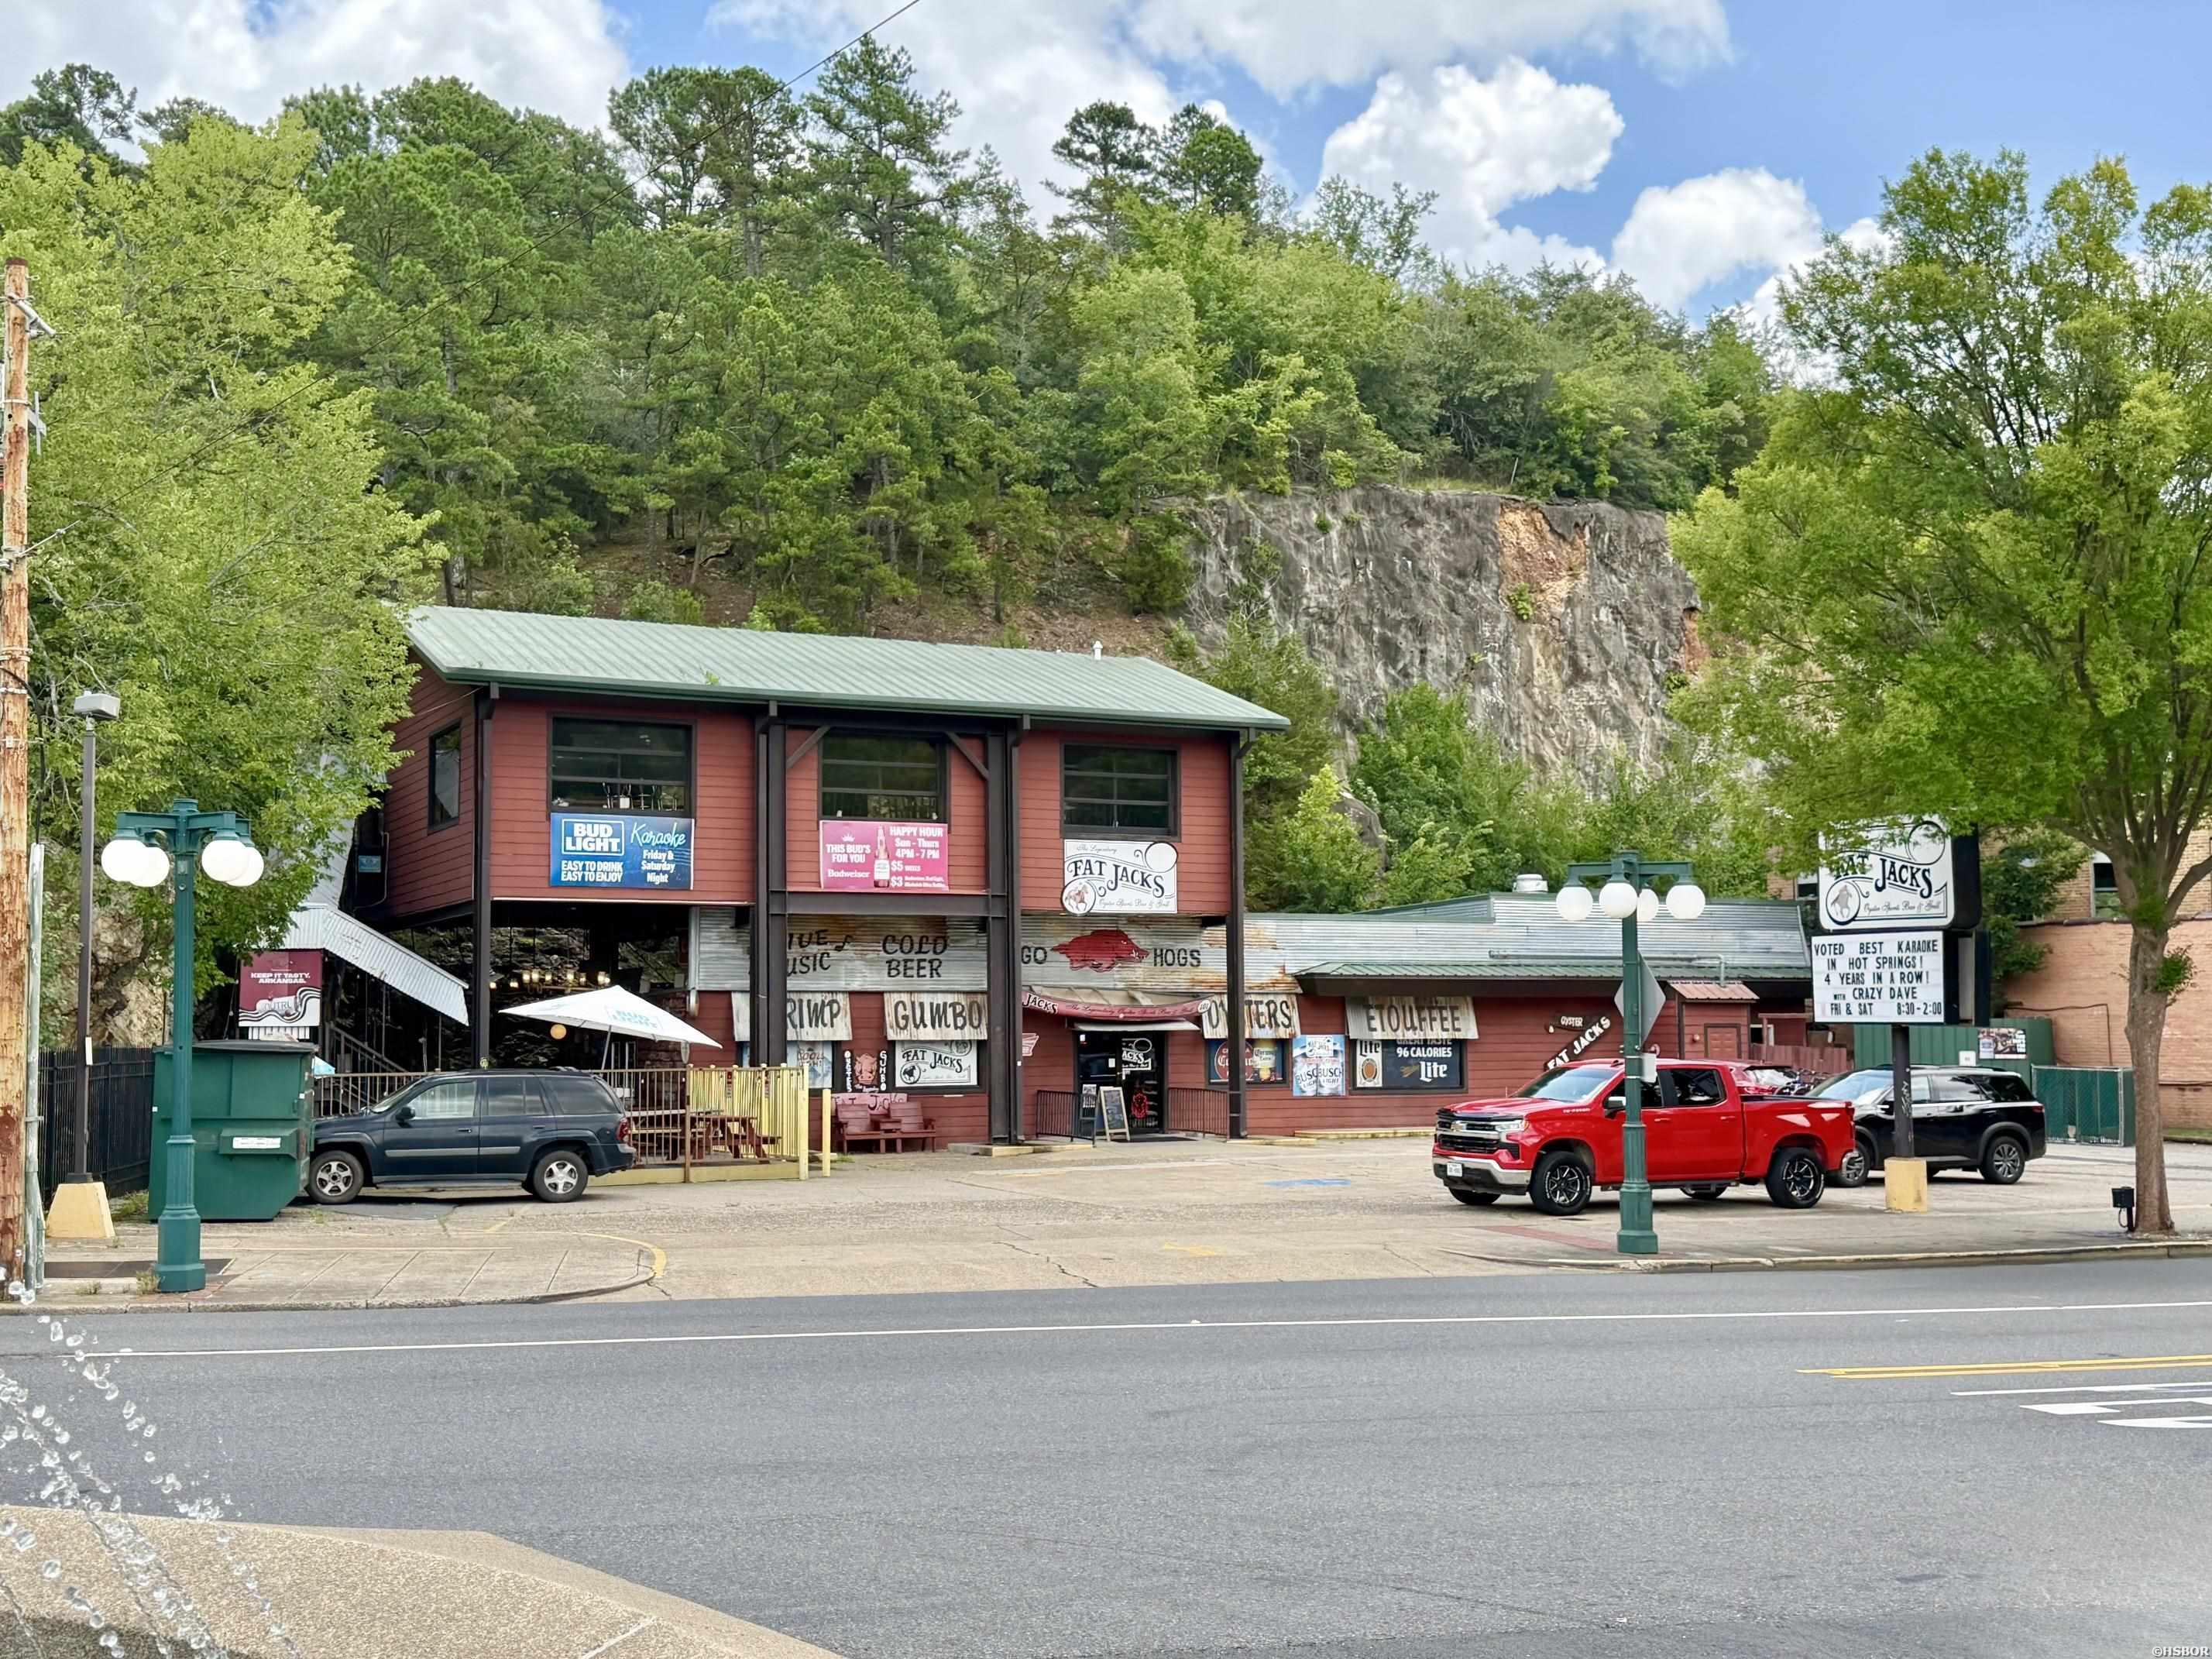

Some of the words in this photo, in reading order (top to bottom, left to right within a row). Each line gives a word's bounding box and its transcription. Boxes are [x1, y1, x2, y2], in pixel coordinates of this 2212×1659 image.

[573, 823, 613, 838] BUD
[630, 822, 687, 847] Karaoke
[889, 826, 918, 836] HAPPY
[919, 827, 943, 837] HOUR
[565, 836, 620, 852] LIGHT
[826, 843, 845, 853] THIS
[846, 844, 871, 854] BUD'S
[895, 838, 912, 847] Sun
[917, 838, 939, 849] Thurs
[643, 850, 667, 862] Friday
[668, 850, 675, 860] &
[831, 854, 848, 863] FOR
[850, 854, 866, 864] YOU
[895, 849, 914, 859] 4PM
[561, 860, 584, 871] EASY
[585, 861, 596, 871] TO
[596, 861, 623, 872] DRINK
[641, 860, 676, 874] Saturday
[827, 868, 871, 878] Budweiser
[891, 860, 904, 873] $5
[561, 871, 584, 881] EASY
[584, 871, 596, 881] TO
[596, 872, 623, 883] ENJOY
[646, 873, 669, 885] Night
[891, 875, 903, 888] $3
[1067, 858, 1108, 878] FAT
[1107, 864, 1165, 898] JACKS
[1874, 857, 1932, 899] JACKS
[788, 929, 829, 950] IVE
[882, 935, 950, 955] COLD
[1814, 943, 1845, 956] VOTED
[1859, 942, 1884, 954] BEST
[1898, 939, 1939, 953] KARAOKE
[1021, 945, 1047, 964] GO
[1153, 948, 1201, 967] HOGS
[1827, 958, 1836, 970] IN
[1849, 957, 1868, 970] HOT
[787, 952, 831, 977] USIC
[886, 958, 943, 978] BEER
[1825, 973, 1830, 985] 4
[1839, 972, 1865, 985] YEARS
[1873, 972, 1882, 984] IN
[1890, 971, 1894, 984] A
[1853, 988, 1883, 1000] CRAZY
[1890, 987, 1917, 999] DAVE
[1022, 994, 1058, 1015] JACKS
[1846, 1003, 1853, 1015] &
[1858, 1003, 1874, 1015] SAT
[787, 998, 841, 1029] RIMP
[894, 1000, 983, 1030] GUMBO
[1208, 999, 1292, 1029] OTERS
[1366, 1005, 1462, 1032] ETOUFFEE
[1560, 1015, 1583, 1028] OYSTER
[1359, 1040, 1381, 1058] Lite
[1547, 1049, 1570, 1070] FAT
[1573, 1016, 1611, 1055] JACKS
[1122, 1050, 1144, 1063] ACKS
[1396, 1046, 1409, 1058] 96
[1410, 1046, 1453, 1058] CALORIES
[902, 1049, 927, 1062] FAT
[929, 1052, 963, 1073] JACKS
[1294, 1067, 1317, 1084] BUSC
[1419, 1060, 1448, 1083] Lite
